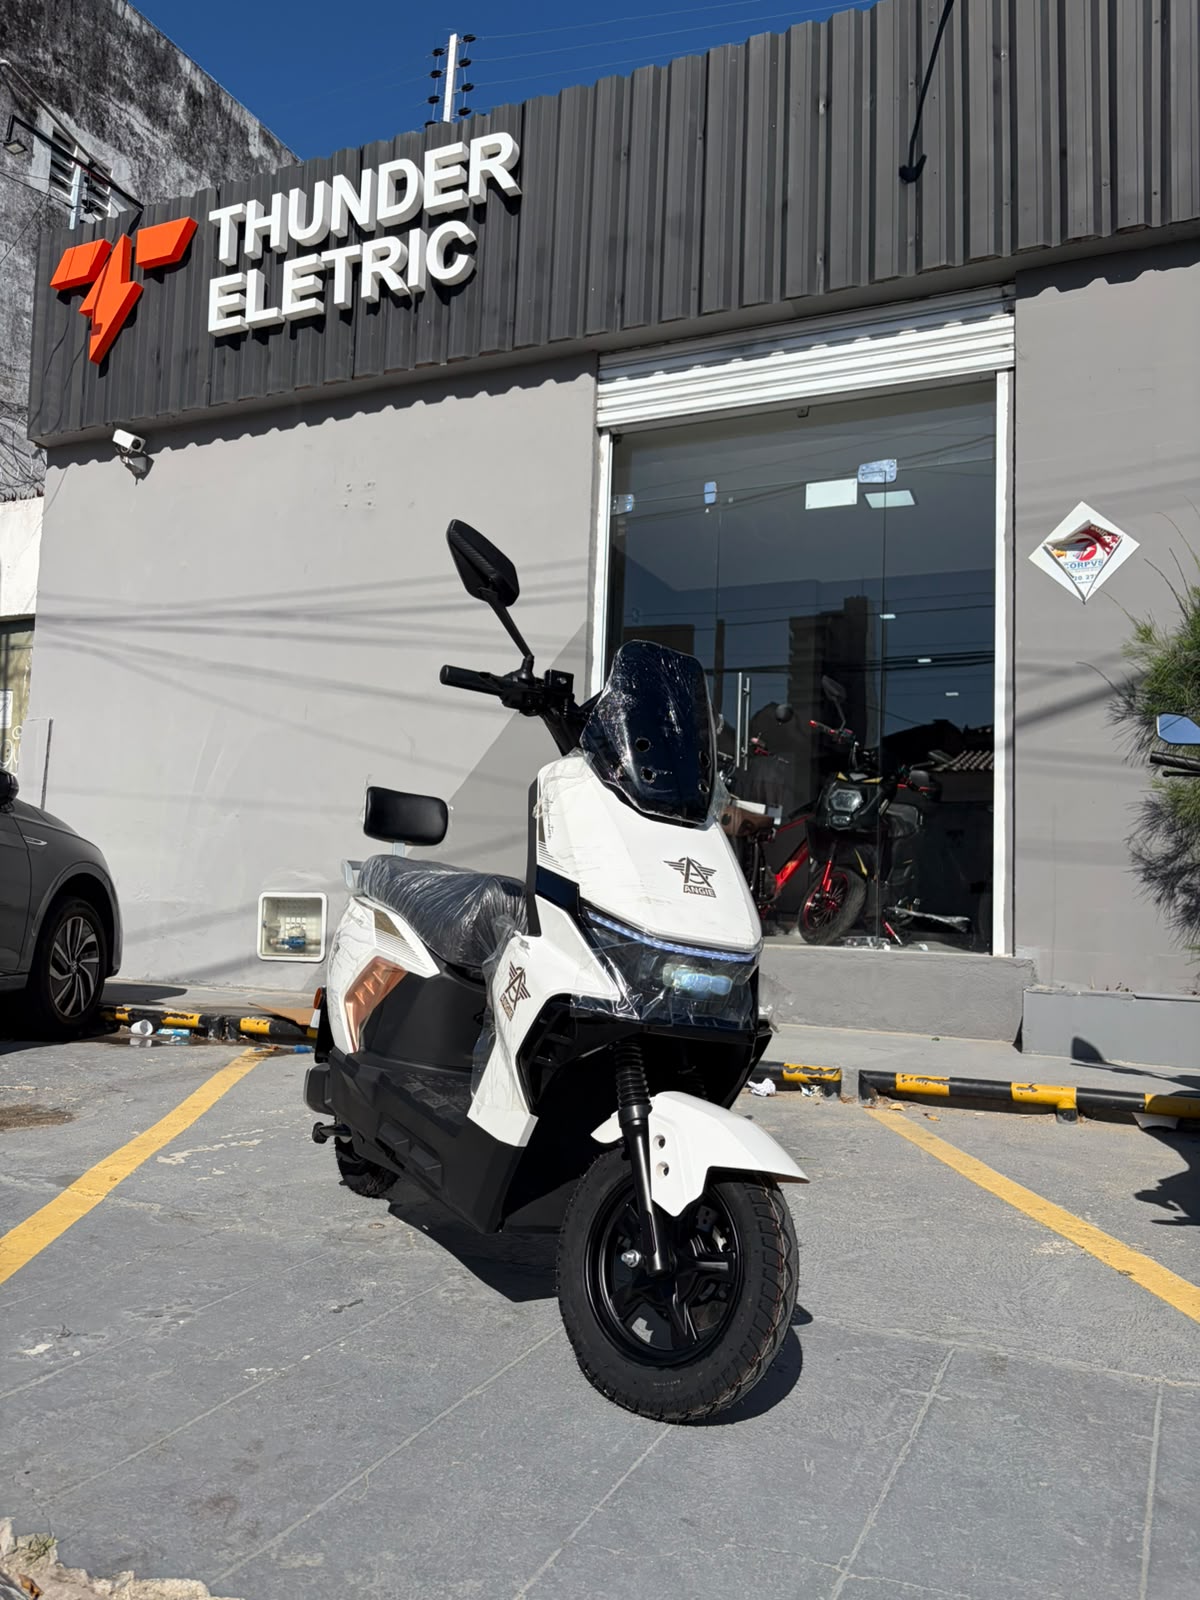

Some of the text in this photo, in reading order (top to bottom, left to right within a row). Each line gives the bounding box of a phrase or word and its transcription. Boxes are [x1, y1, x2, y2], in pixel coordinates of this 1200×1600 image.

[208, 131, 523, 267] THUNDER
[207, 220, 477, 337] ELETRIC
[684, 885, 715, 898] ANGIE
